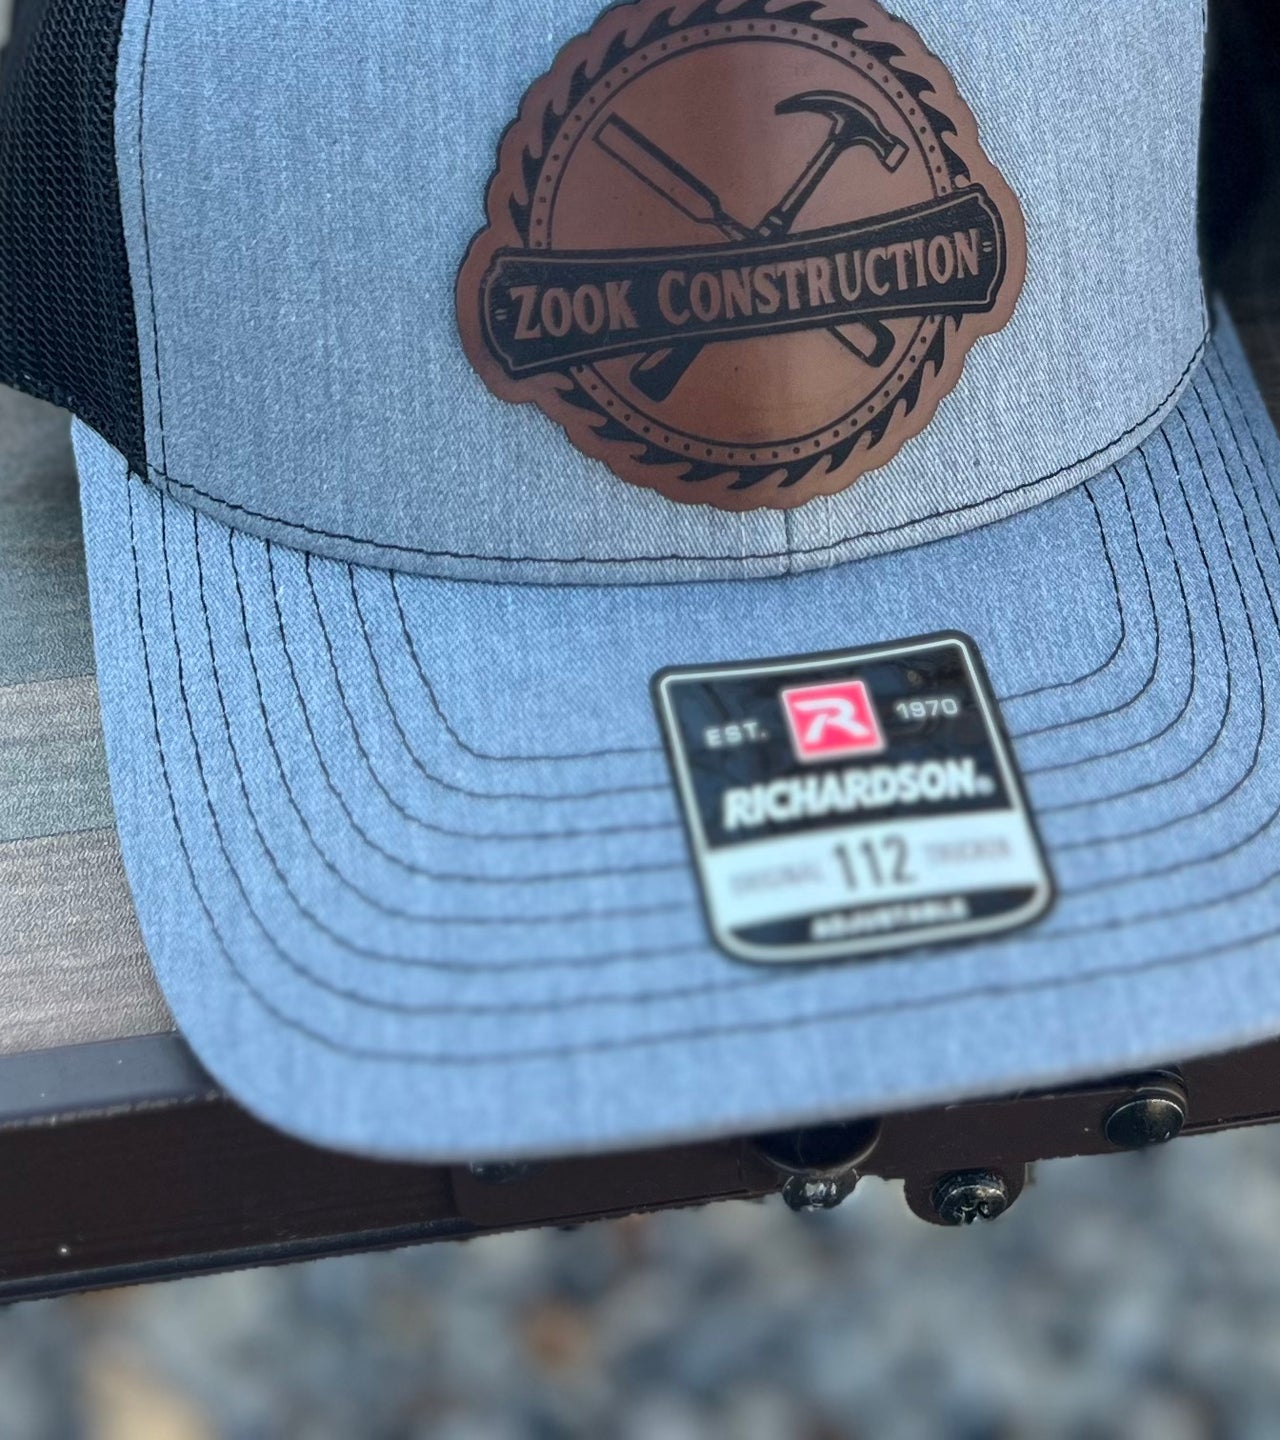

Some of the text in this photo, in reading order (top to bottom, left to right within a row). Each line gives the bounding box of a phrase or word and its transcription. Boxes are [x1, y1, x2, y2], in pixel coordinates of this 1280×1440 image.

[508, 227, 981, 341] ZOOK CONSTRUCTION
[703, 720, 769, 749] EST.
[895, 697, 959, 720] 1970
[832, 834, 918, 891] 112
